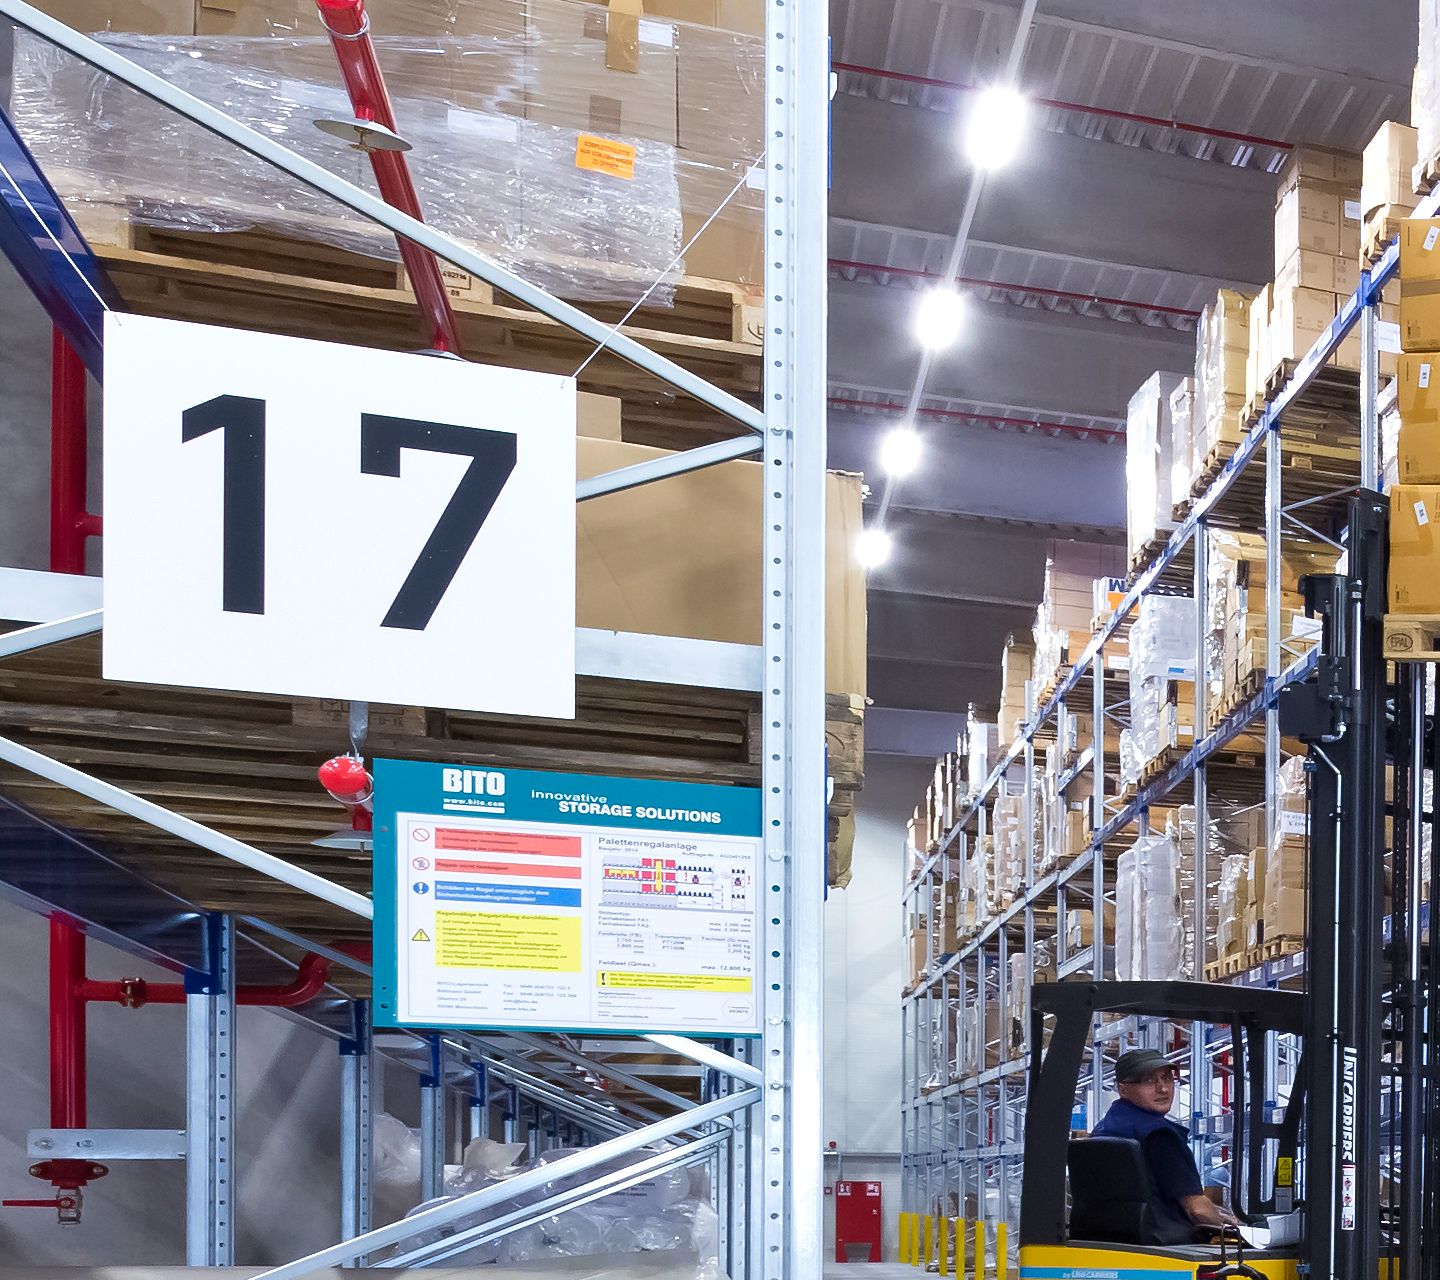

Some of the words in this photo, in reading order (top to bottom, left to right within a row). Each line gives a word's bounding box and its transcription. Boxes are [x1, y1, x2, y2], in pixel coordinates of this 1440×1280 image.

[181, 394, 518, 631] 17
[1391, 637, 1409, 648] EPAL
[443, 768, 505, 796] BITO
[443, 797, 505, 806] www.bito.com
[531, 789, 607, 803] innovative
[558, 801, 632, 817] STORAGE
[635, 806, 721, 824] SOLUTIONS
[598, 837, 698, 851] Palettenregalanlage
